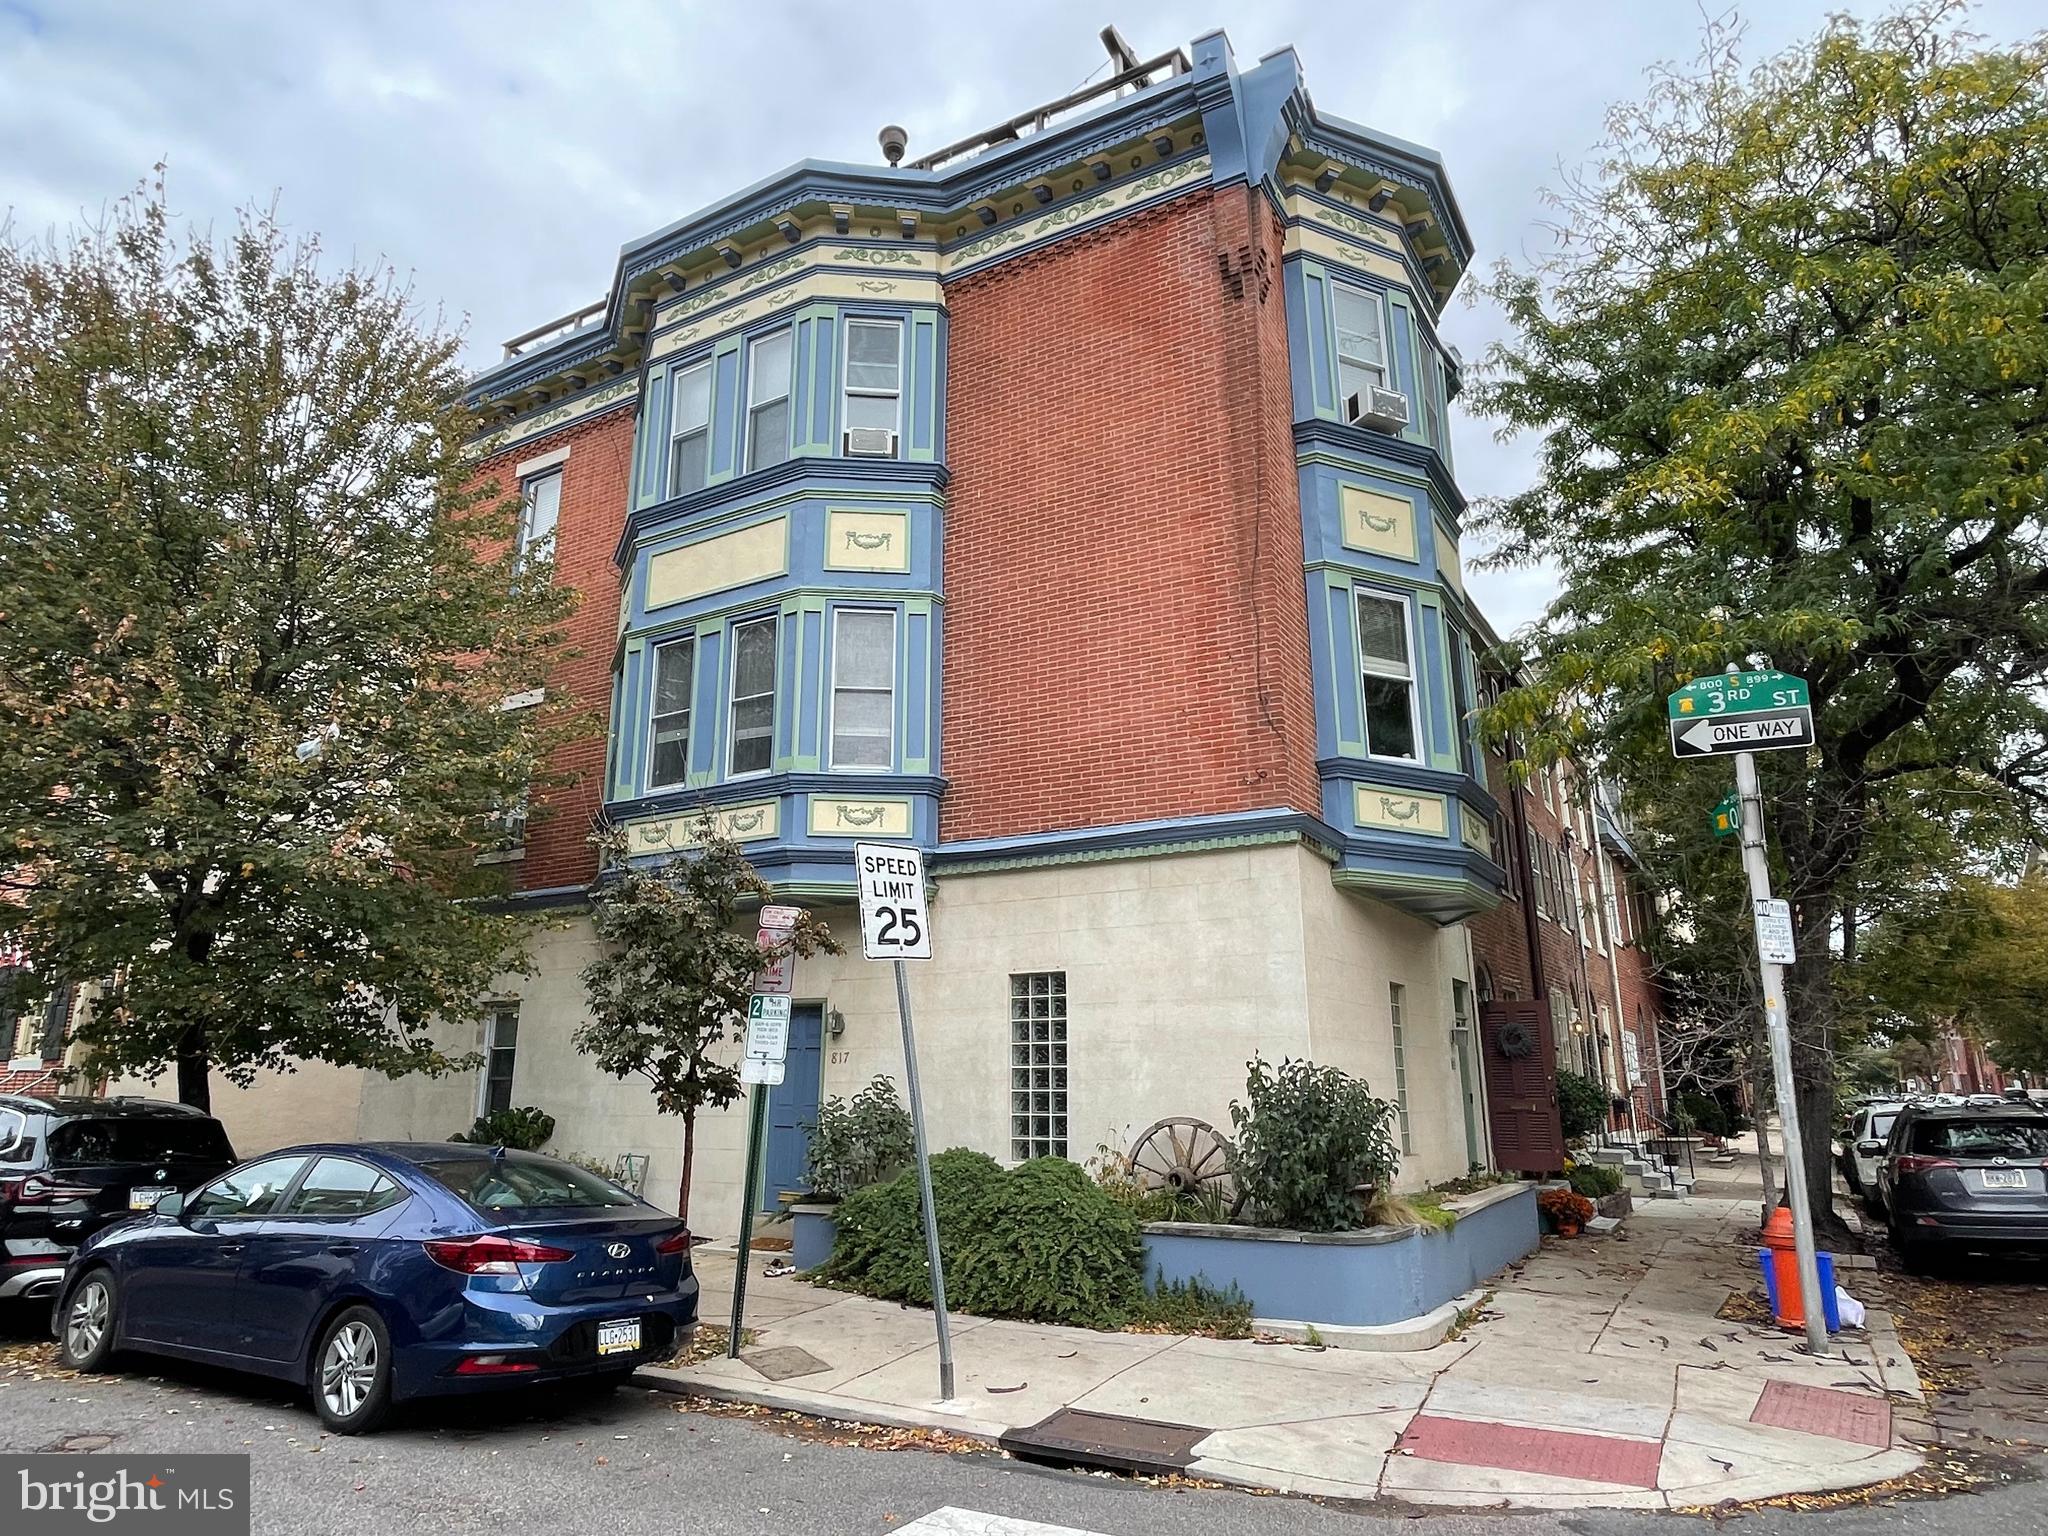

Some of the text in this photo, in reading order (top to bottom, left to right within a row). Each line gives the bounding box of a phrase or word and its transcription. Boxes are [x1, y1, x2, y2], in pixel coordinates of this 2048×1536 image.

[1700, 675, 1769, 690] 800 S 899
[1707, 688, 1800, 713] 3RD ST
[1713, 720, 1795, 741] ONE WAY
[865, 856, 917, 876] SPEED
[873, 880, 913, 899] LIMIT
[1757, 901, 1769, 915] NO
[875, 906, 921, 946] 25
[752, 999, 761, 1016] 2
[763, 1008, 788, 1018] PARKING
[831, 1052, 850, 1065] 817
